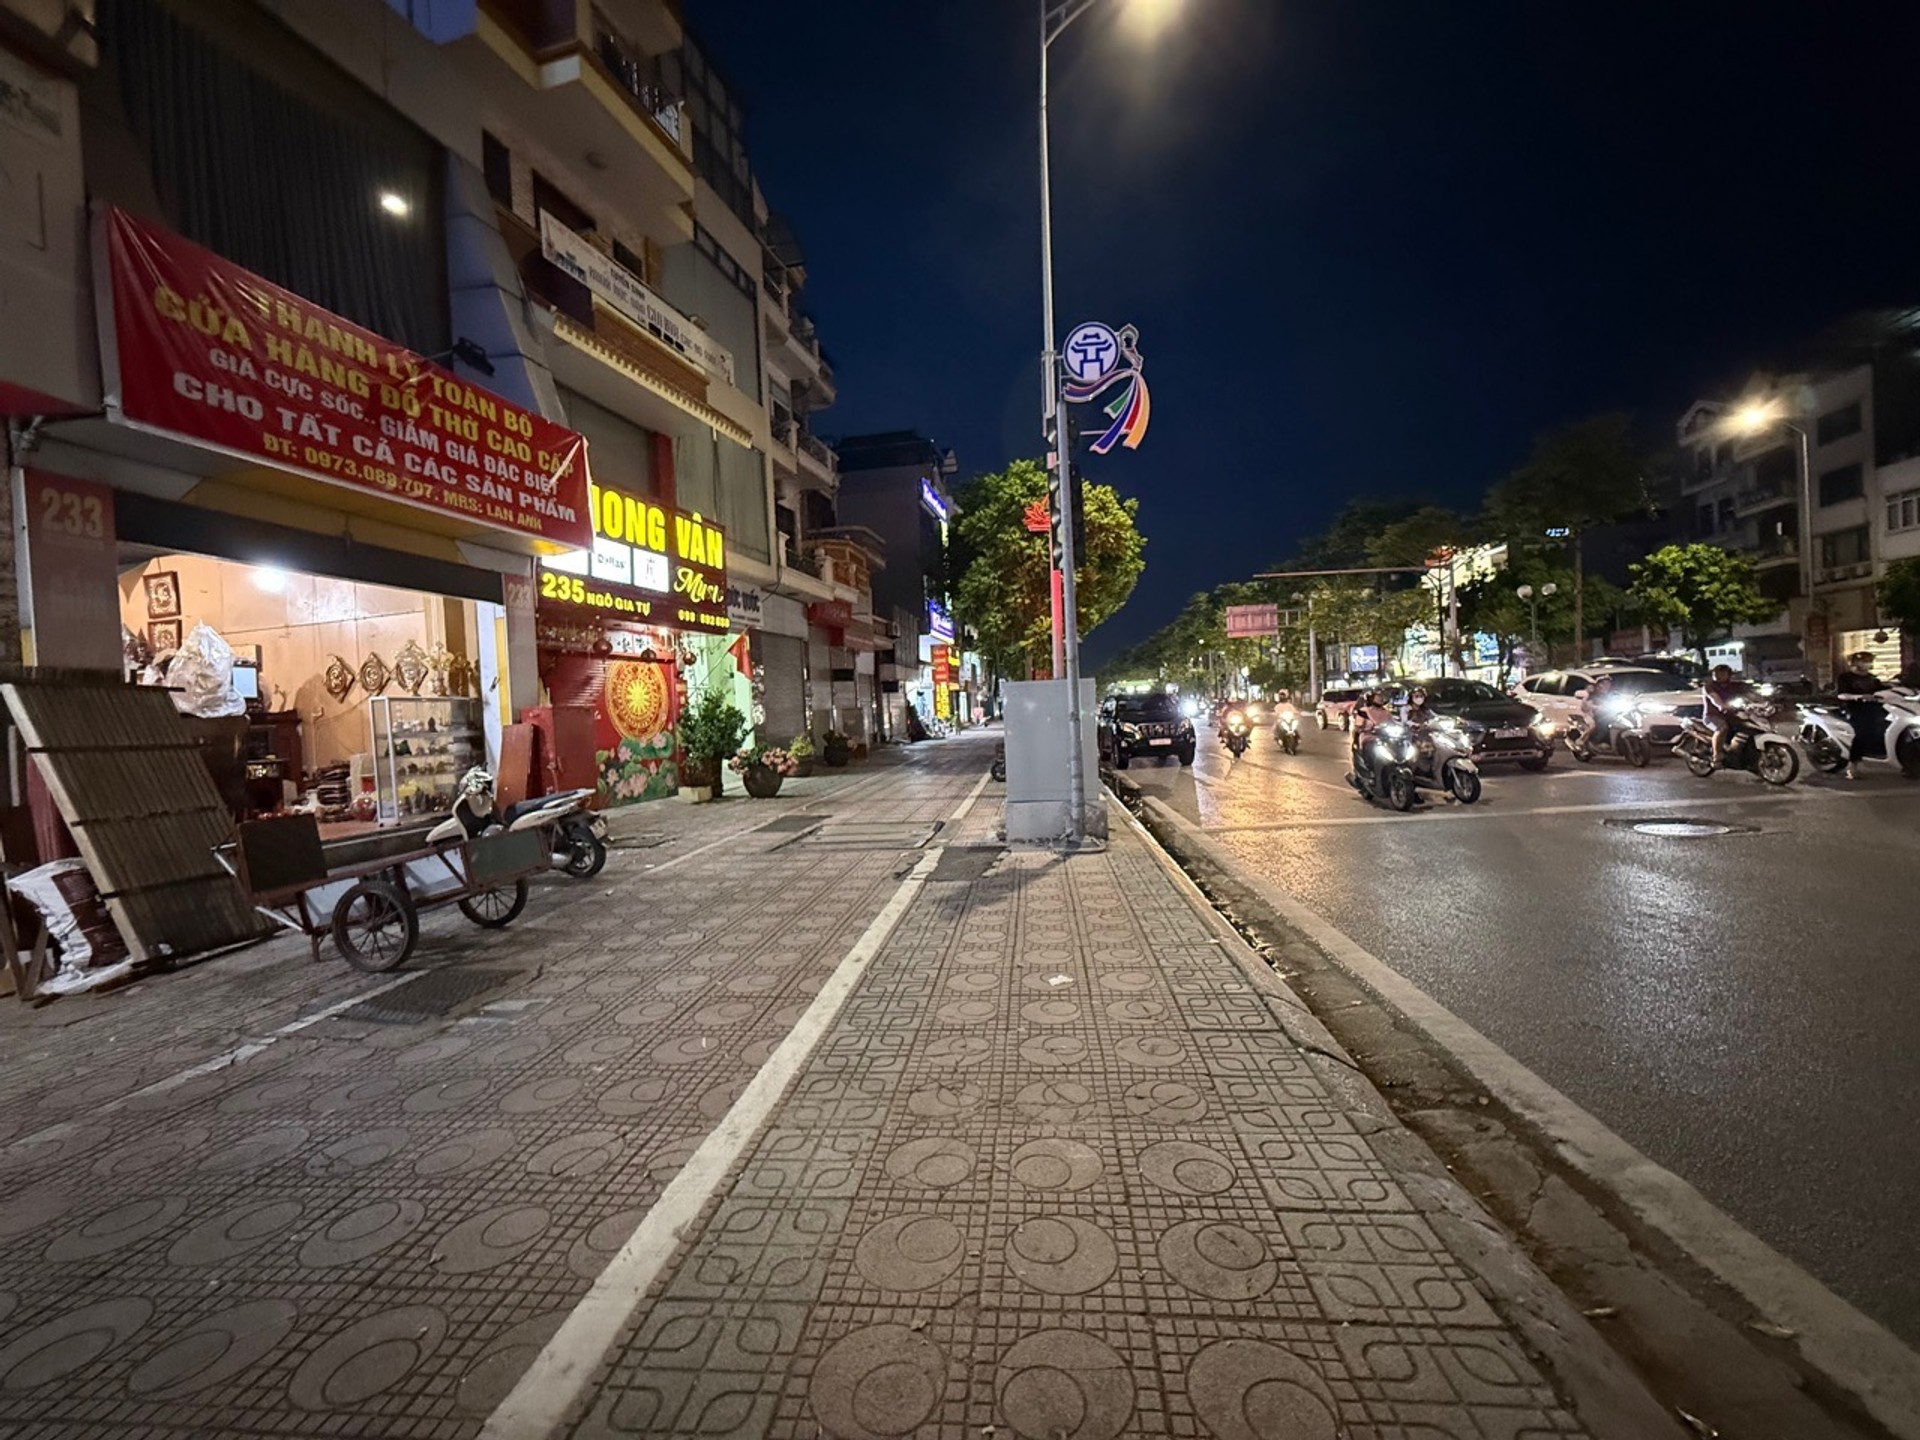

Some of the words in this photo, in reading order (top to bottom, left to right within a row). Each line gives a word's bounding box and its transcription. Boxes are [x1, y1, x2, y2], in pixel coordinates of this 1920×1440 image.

[209, 348, 259, 381] GIÁ
[264, 368, 314, 401] CỰC
[380, 413, 440, 454] GIẢM
[445, 439, 480, 468] GIÁ
[484, 453, 521, 486] ĐẶC
[524, 469, 558, 497] BIỆT
[254, 287, 378, 369] THANH
[431, 372, 497, 422] TOÀN
[503, 408, 533, 442] BỘ
[265, 331, 371, 398] HÀNG
[429, 402, 480, 442] THỜ
[486, 428, 533, 463] CAO
[172, 370, 265, 422] CHO
[276, 405, 342, 447] TẤT
[352, 436, 396, 466] CẢ
[404, 451, 458, 486] CÁC
[465, 473, 513, 503] SẢN
[519, 491, 577, 523] PHẨM
[263, 431, 299, 459] ĐT:
[444, 489, 484, 514] MRS:
[486, 502, 514, 523] LAN
[517, 511, 543, 531] ANH
[41, 487, 104, 538] 233
[675, 511, 724, 570] VÂN
[541, 572, 586, 604] 235
[586, 590, 613, 609] NGÔ
[614, 596, 635, 613] GIA
[635, 601, 651, 617] TỰ
